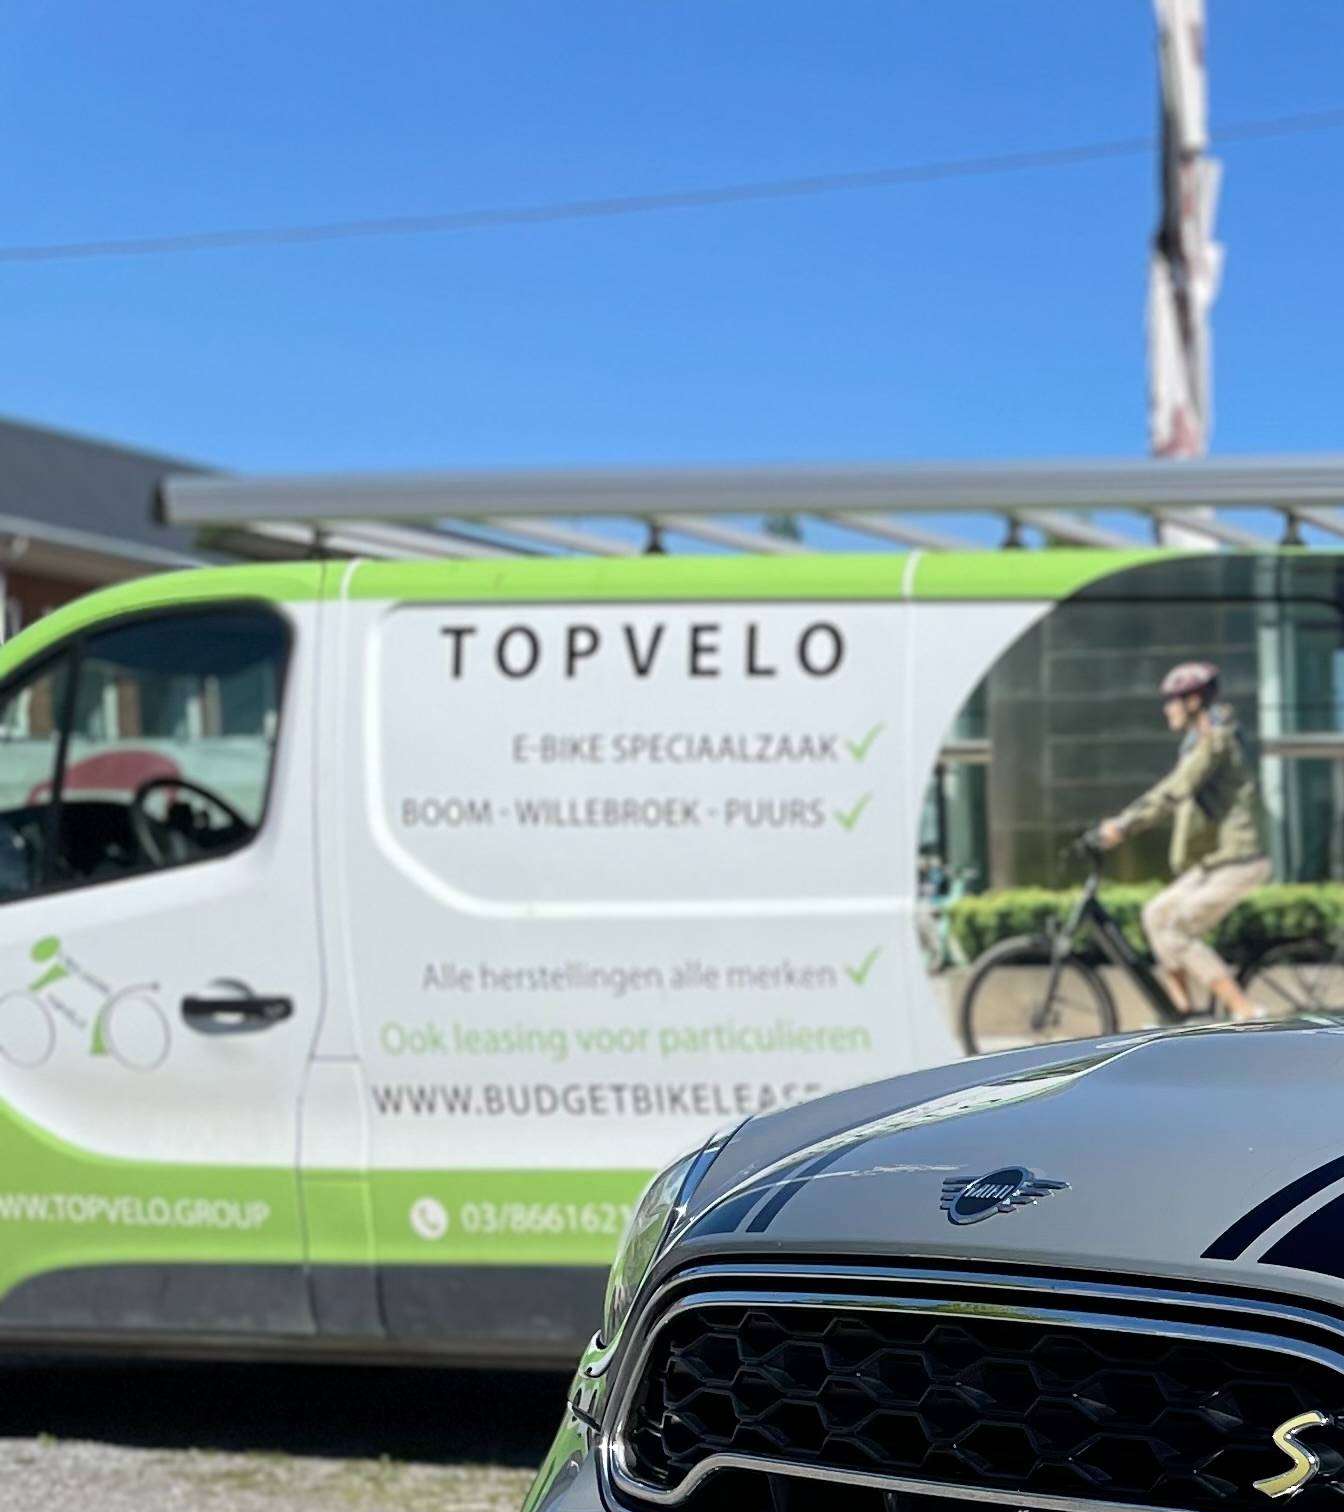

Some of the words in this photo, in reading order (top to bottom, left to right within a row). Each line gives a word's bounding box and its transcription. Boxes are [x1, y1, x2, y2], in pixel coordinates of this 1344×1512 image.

[439, 620, 847, 680] TOPVELO
[511, 734, 604, 764] E-BIKE
[611, 733, 839, 764] SPECIAALZAAK
[401, 799, 493, 828] BOOM
[515, 798, 701, 829] WILLEBROEK
[725, 798, 826, 829] PUURS
[421, 963, 473, 993] Alle
[479, 962, 664, 998] herstellingen
[670, 959, 720, 990] alle
[726, 958, 837, 989] merken
[380, 1021, 445, 1055] Ook
[452, 1021, 570, 1063] leasing
[576, 1026, 650, 1054] voor
[659, 1018, 872, 1061] particulieren
